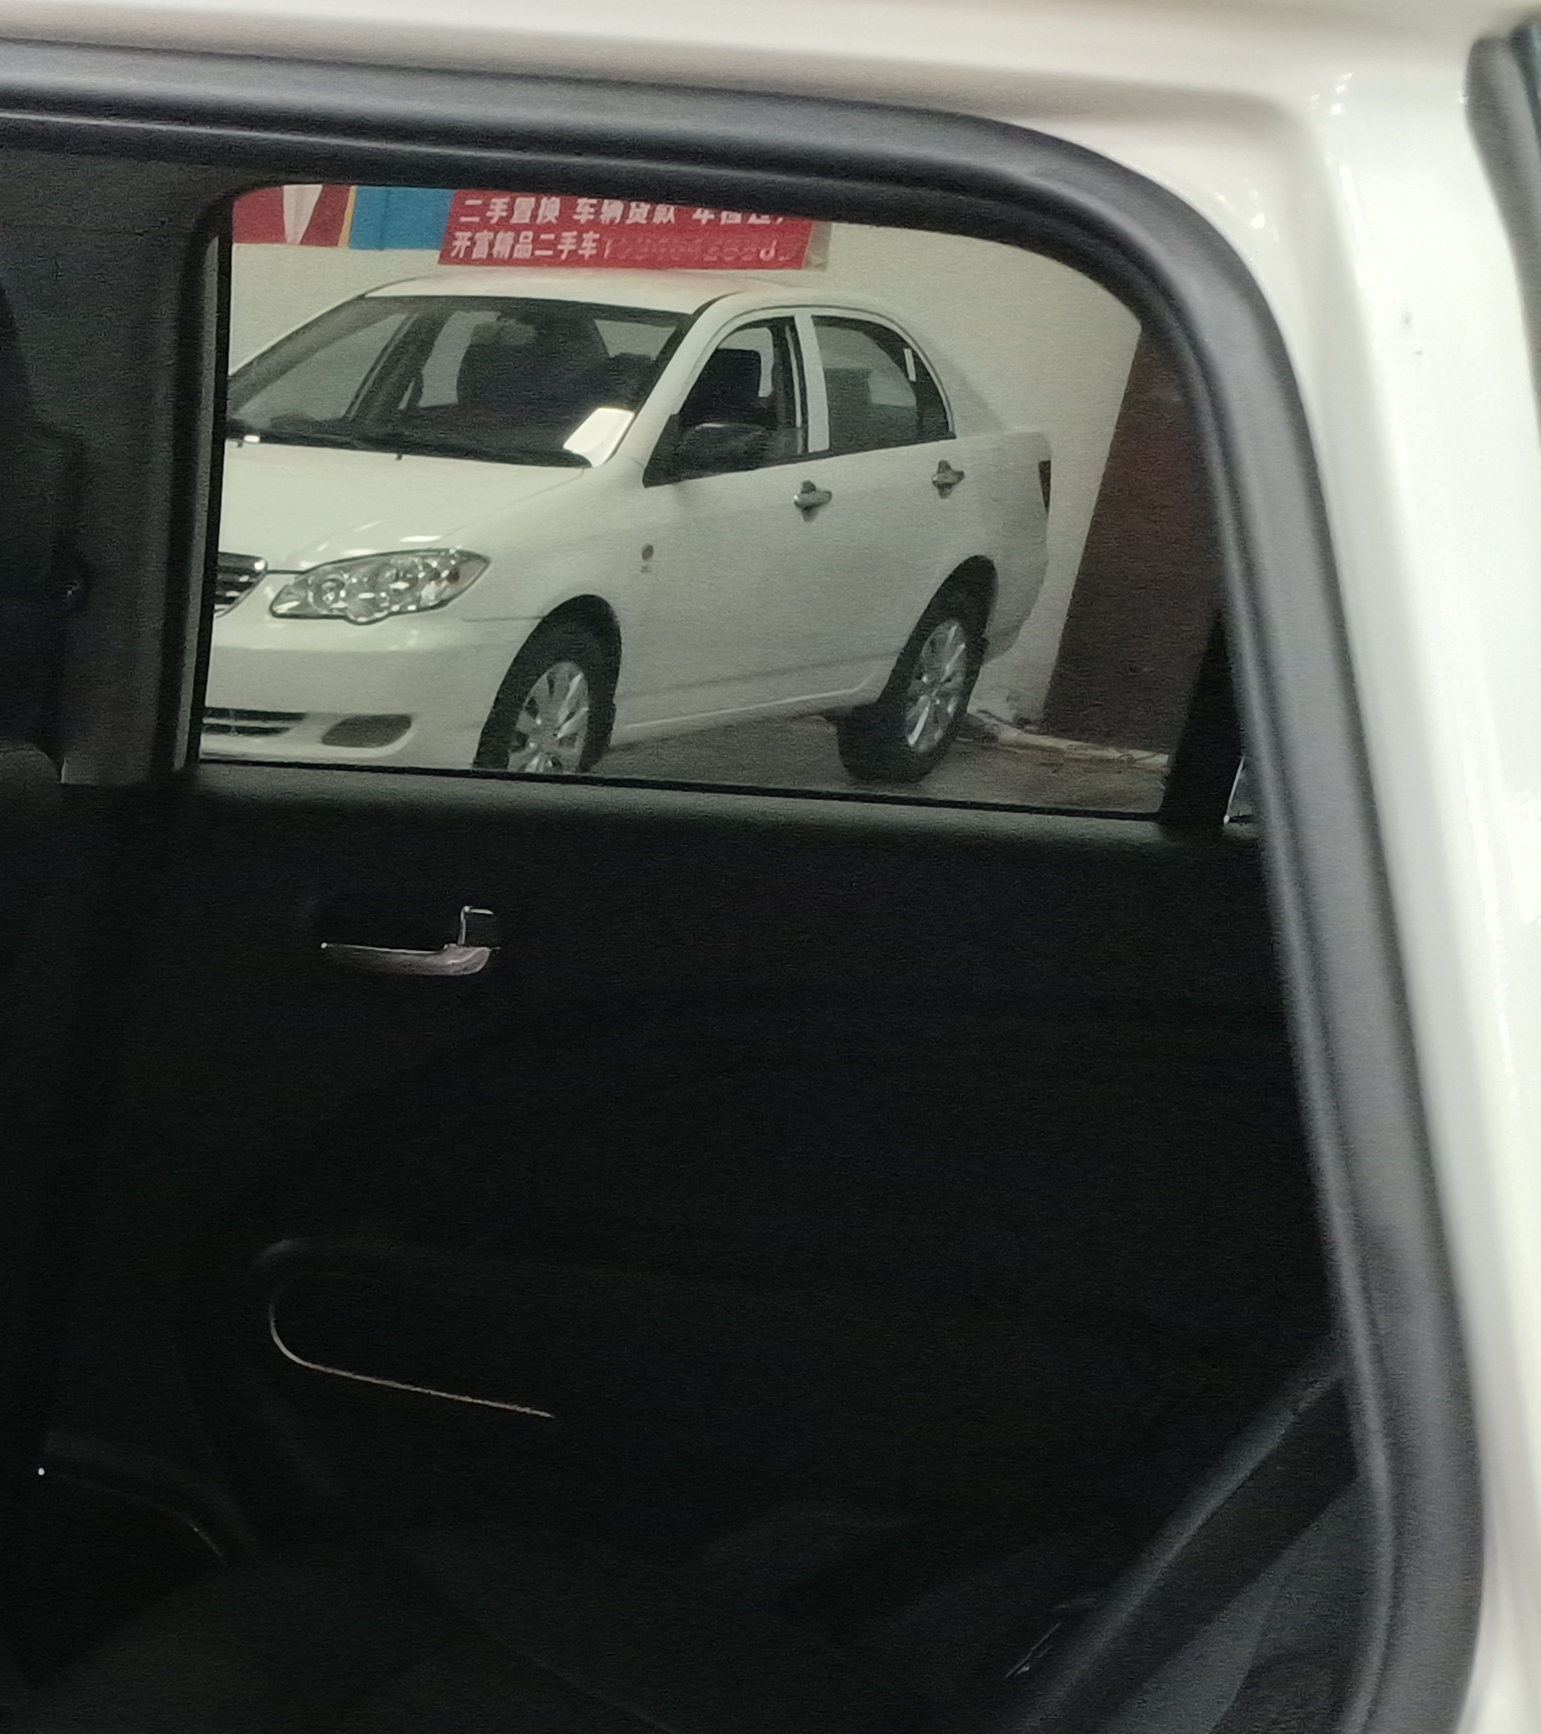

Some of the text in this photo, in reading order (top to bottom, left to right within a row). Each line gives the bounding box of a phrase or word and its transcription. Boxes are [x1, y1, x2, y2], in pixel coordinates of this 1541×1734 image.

[459, 196, 561, 225] 二手置换
[573, 197, 677, 225] 车辆贷款
